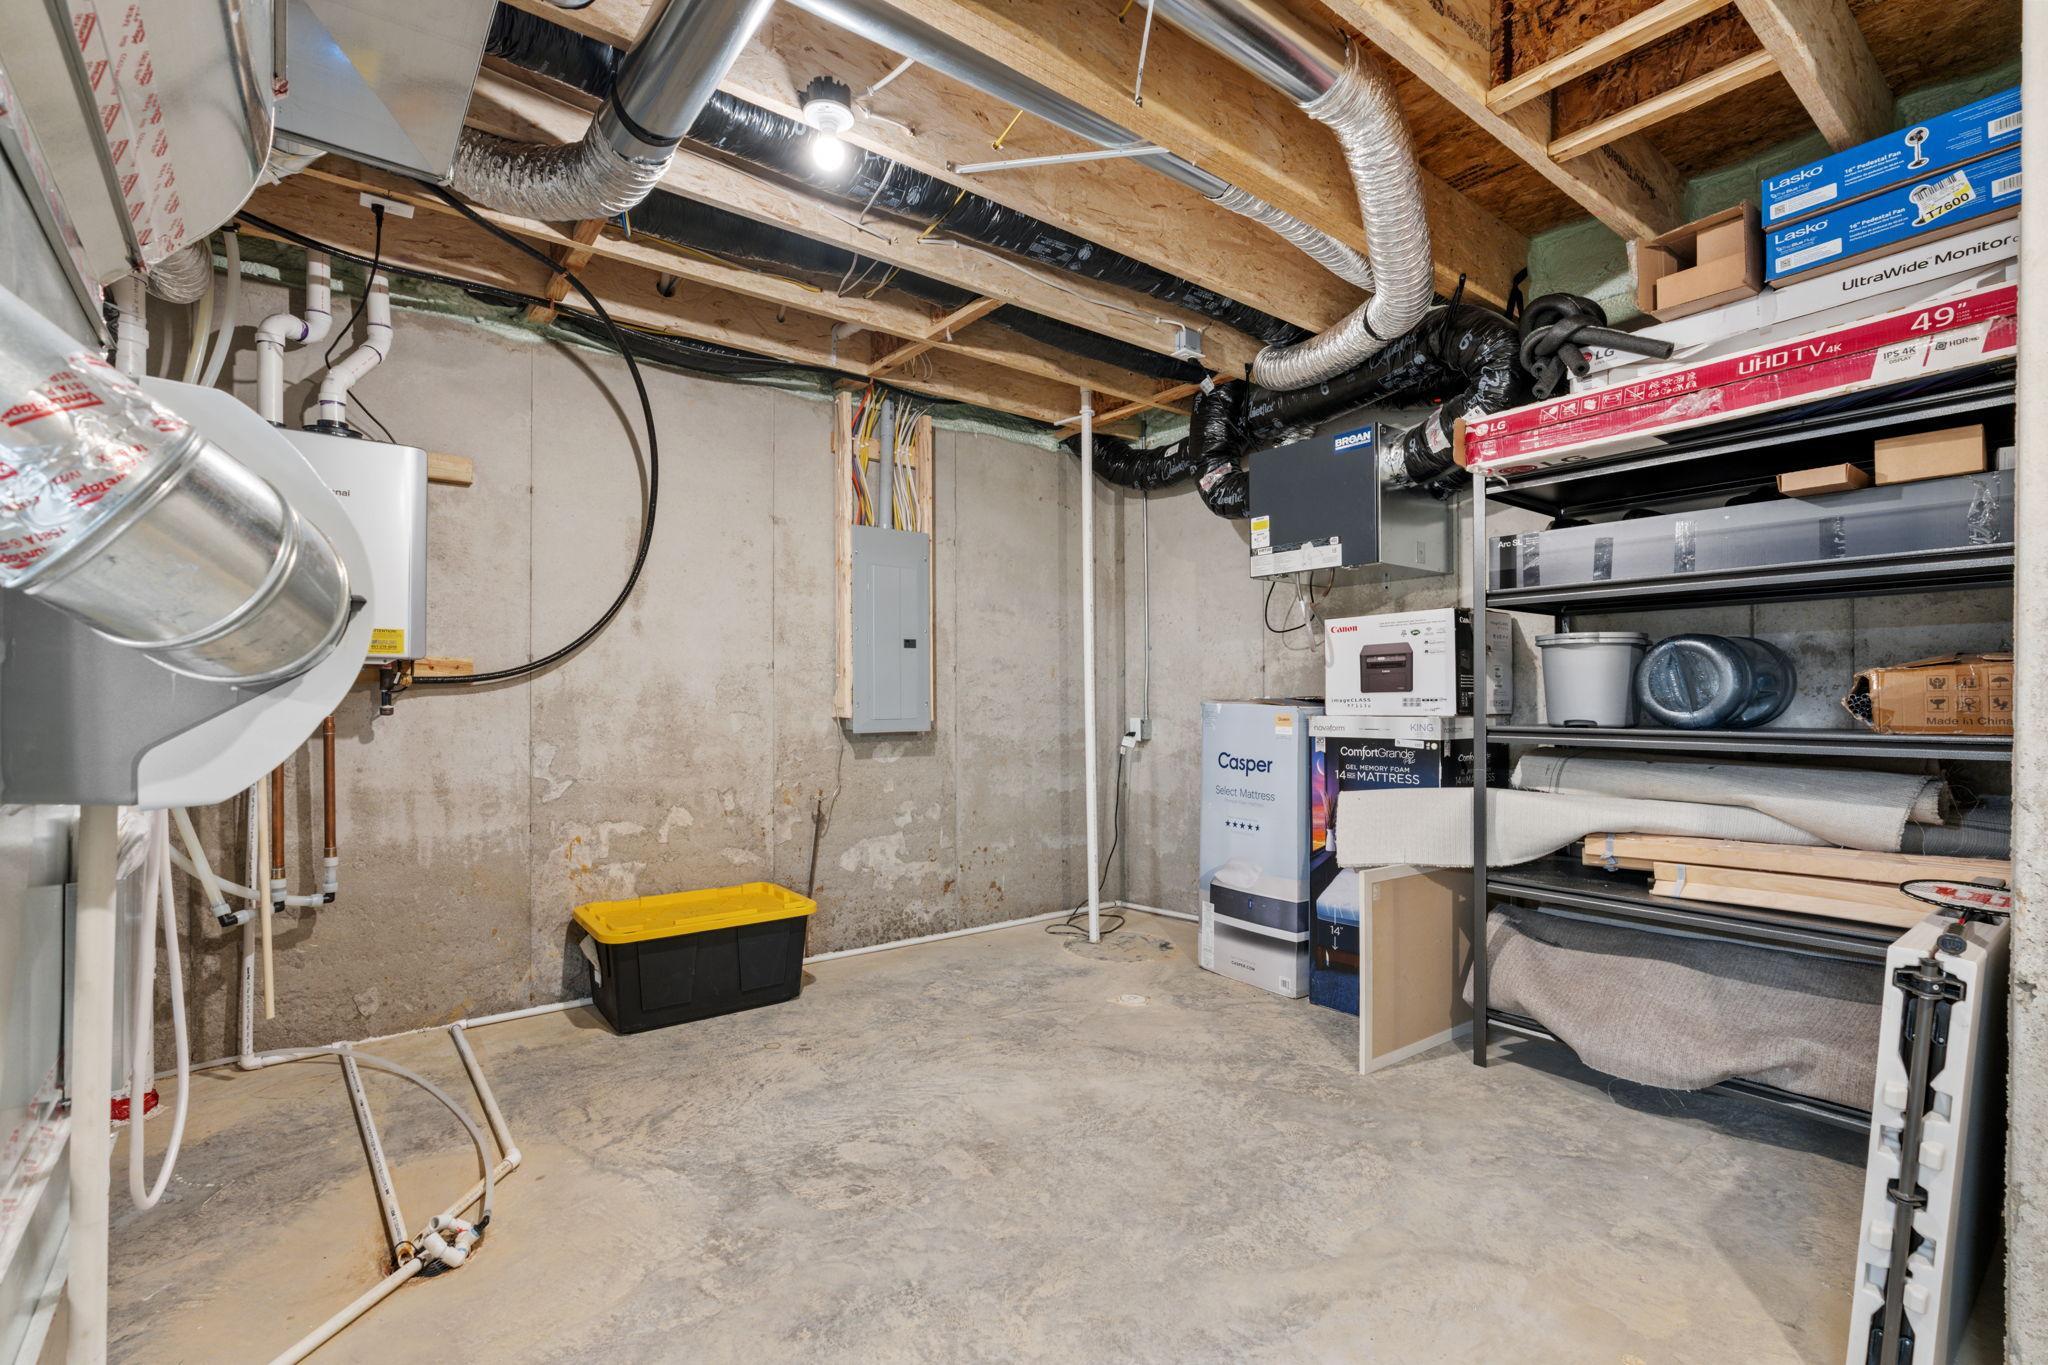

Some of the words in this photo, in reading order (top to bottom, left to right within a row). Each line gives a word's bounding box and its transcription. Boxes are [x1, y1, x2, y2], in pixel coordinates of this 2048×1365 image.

[1857, 156, 1887, 169] Pedestal
[1888, 150, 1902, 159] Fan
[1769, 165, 1823, 192] Lasko
[1926, 192, 1971, 219] T7600
[1861, 212, 1892, 226] Pedestal
[1892, 207, 1906, 216] Fan
[1775, 219, 1828, 244] Lasko
[1934, 235, 2012, 265] Monitor
[1595, 347, 1615, 360] LG
[1738, 352, 1789, 375] UHD
[1792, 341, 1826, 361] TV
[1826, 343, 1842, 354] 4K
[1883, 350, 1899, 360] IPS
[1902, 346, 1916, 355] 4K
[1888, 356, 1912, 365] DISPLAY
[1490, 421, 1506, 432] LG
[1335, 431, 1371, 447] BROAN
[1498, 540, 1511, 549] Arc
[1512, 539, 1523, 547] SL
[1331, 625, 1358, 634] Canon
[1313, 724, 1345, 733] novaform
[1410, 723, 1434, 732] KING
[1926, 717, 1959, 725] Made
[1963, 717, 1973, 725] in
[1977, 716, 2013, 726] China
[1340, 745, 1415, 760] ComfortGrande
[1218, 752, 1273, 777] Casper
[1335, 769, 1346, 780] 14
[1357, 772, 1420, 785] MATTRESS
[1215, 784, 1237, 798] Select
[1240, 788, 1276, 801] Mattress
[1330, 925, 1343, 936] 14"
